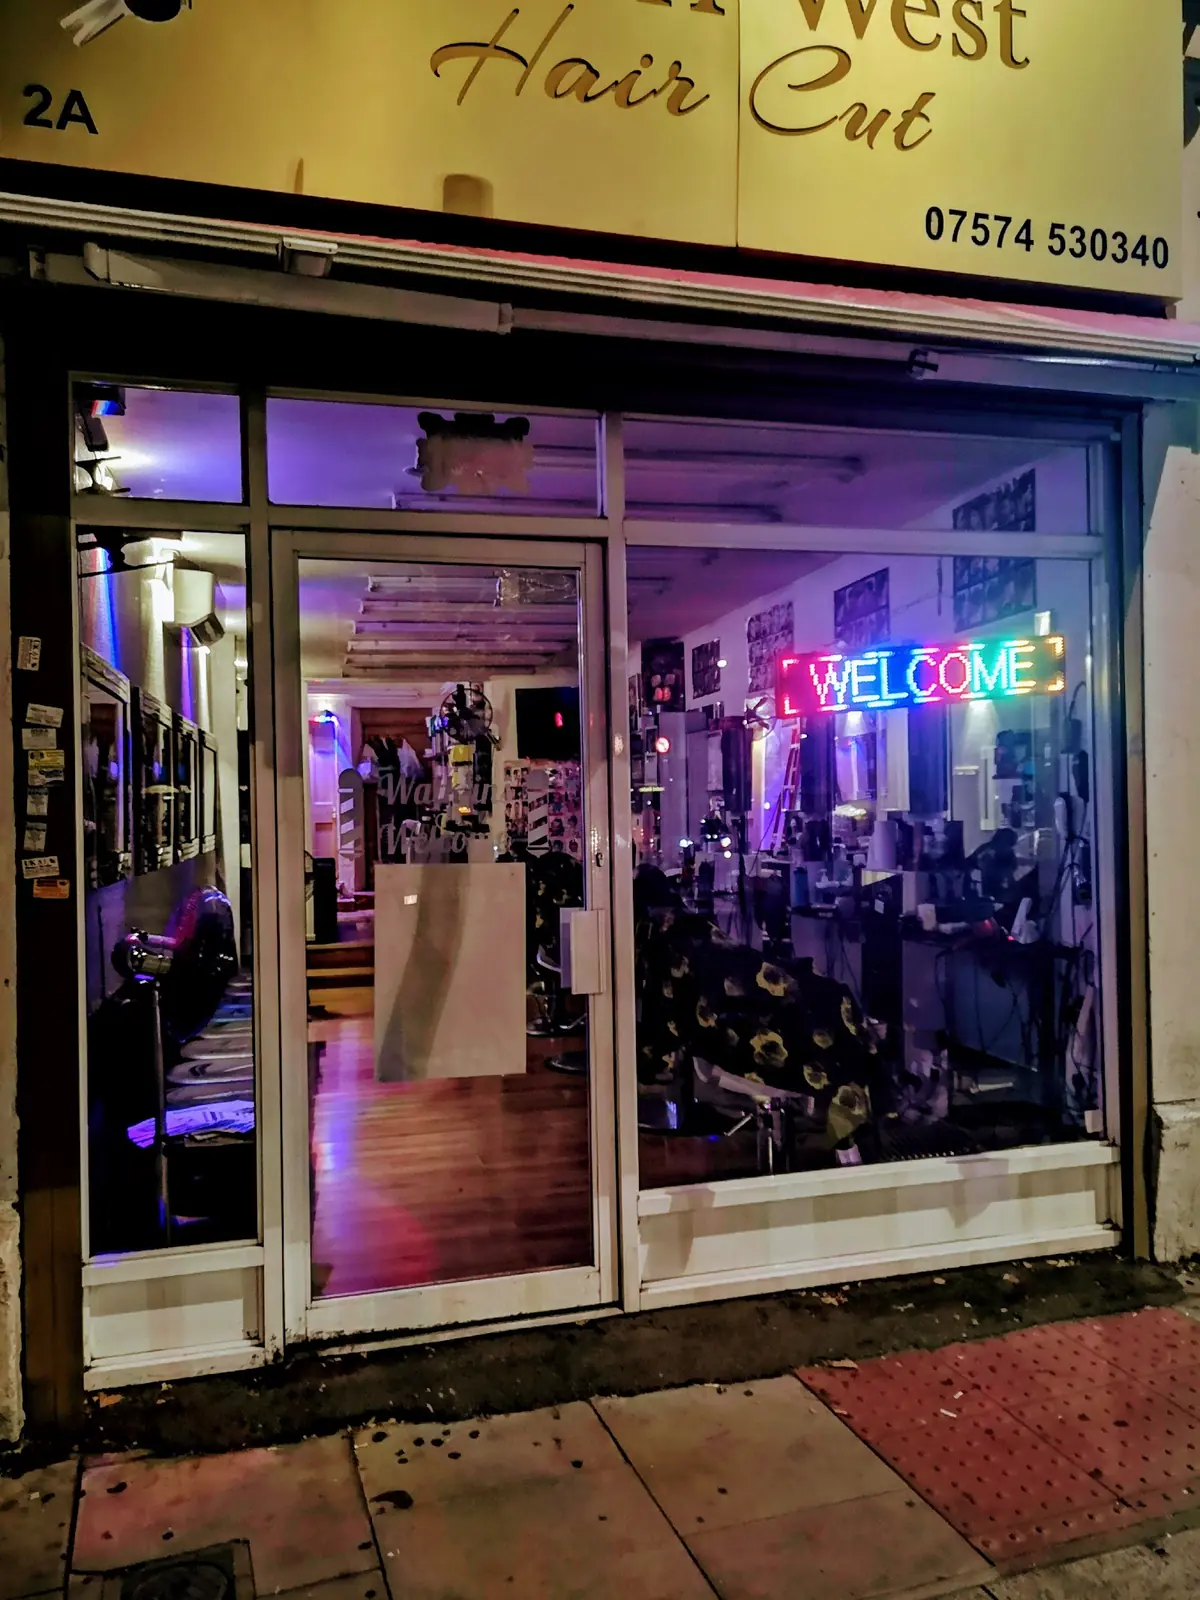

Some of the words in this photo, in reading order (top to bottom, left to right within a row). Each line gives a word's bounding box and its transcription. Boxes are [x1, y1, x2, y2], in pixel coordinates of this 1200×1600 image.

[430, 3, 711, 117] Hair
[749, 44, 936, 152] Cut
[22, 84, 99, 135] 2A
[925, 206, 1034, 252] 07574
[1047, 222, 1169, 269] 530340
[808, 646, 1037, 705] WELCOME
